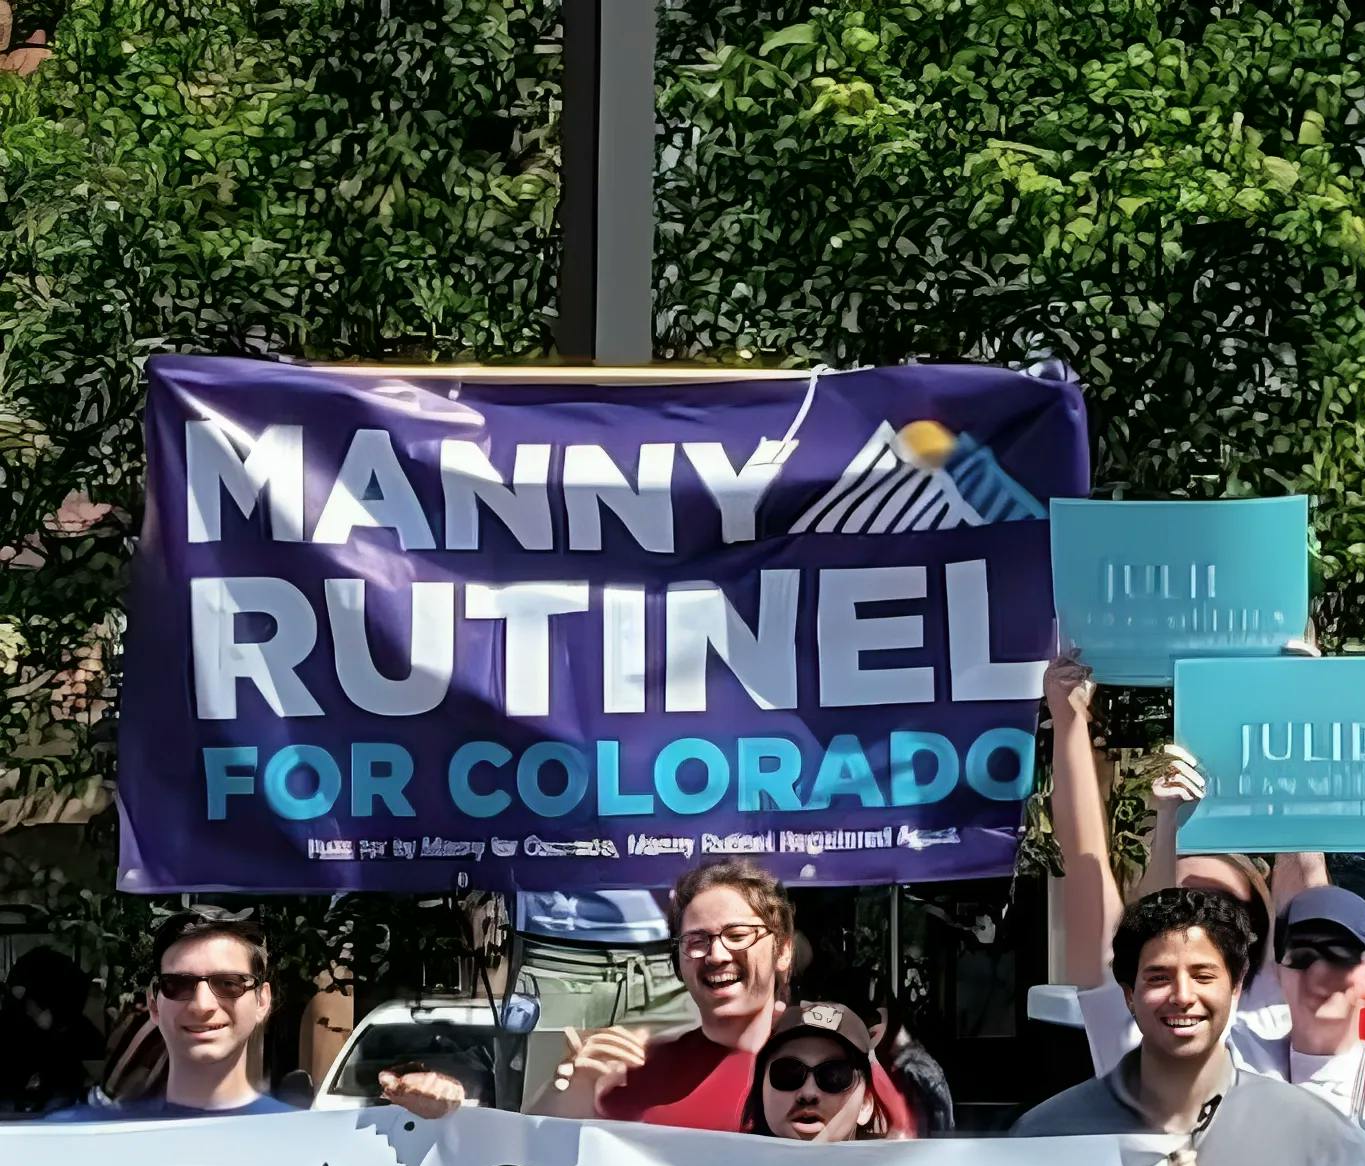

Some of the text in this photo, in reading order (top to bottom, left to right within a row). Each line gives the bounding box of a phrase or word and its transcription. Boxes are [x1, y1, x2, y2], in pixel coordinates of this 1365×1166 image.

[185, 417, 801, 554] MANNY
[188, 558, 1051, 722] RUTINEL
[203, 726, 1036, 821] FOR COLORADO
